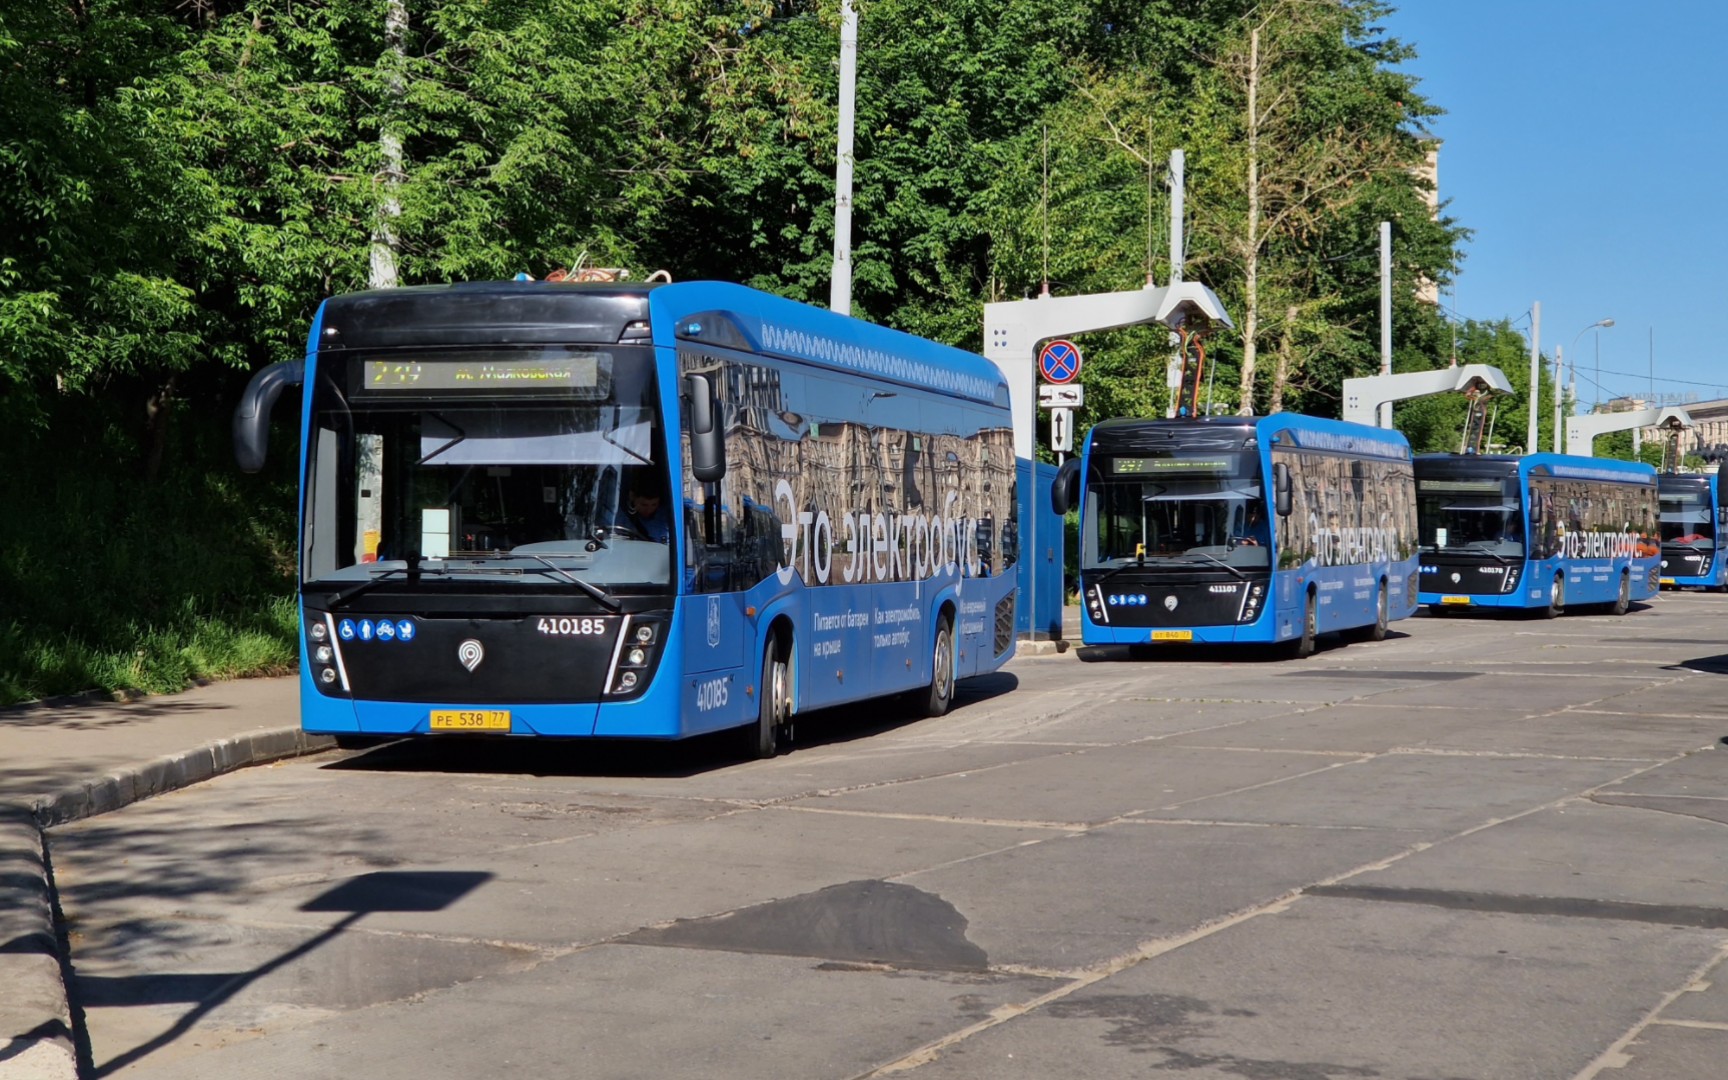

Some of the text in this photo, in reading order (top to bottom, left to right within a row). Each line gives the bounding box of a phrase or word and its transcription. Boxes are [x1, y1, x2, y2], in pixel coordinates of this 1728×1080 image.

[775, 479, 833, 586] Это
[1557, 520, 1580, 559] Это
[537, 618, 605, 635] 410185
[814, 642, 822, 657] на
[697, 677, 728, 712] 410185
[459, 712, 484, 726] 538
[492, 711, 505, 723] 77
